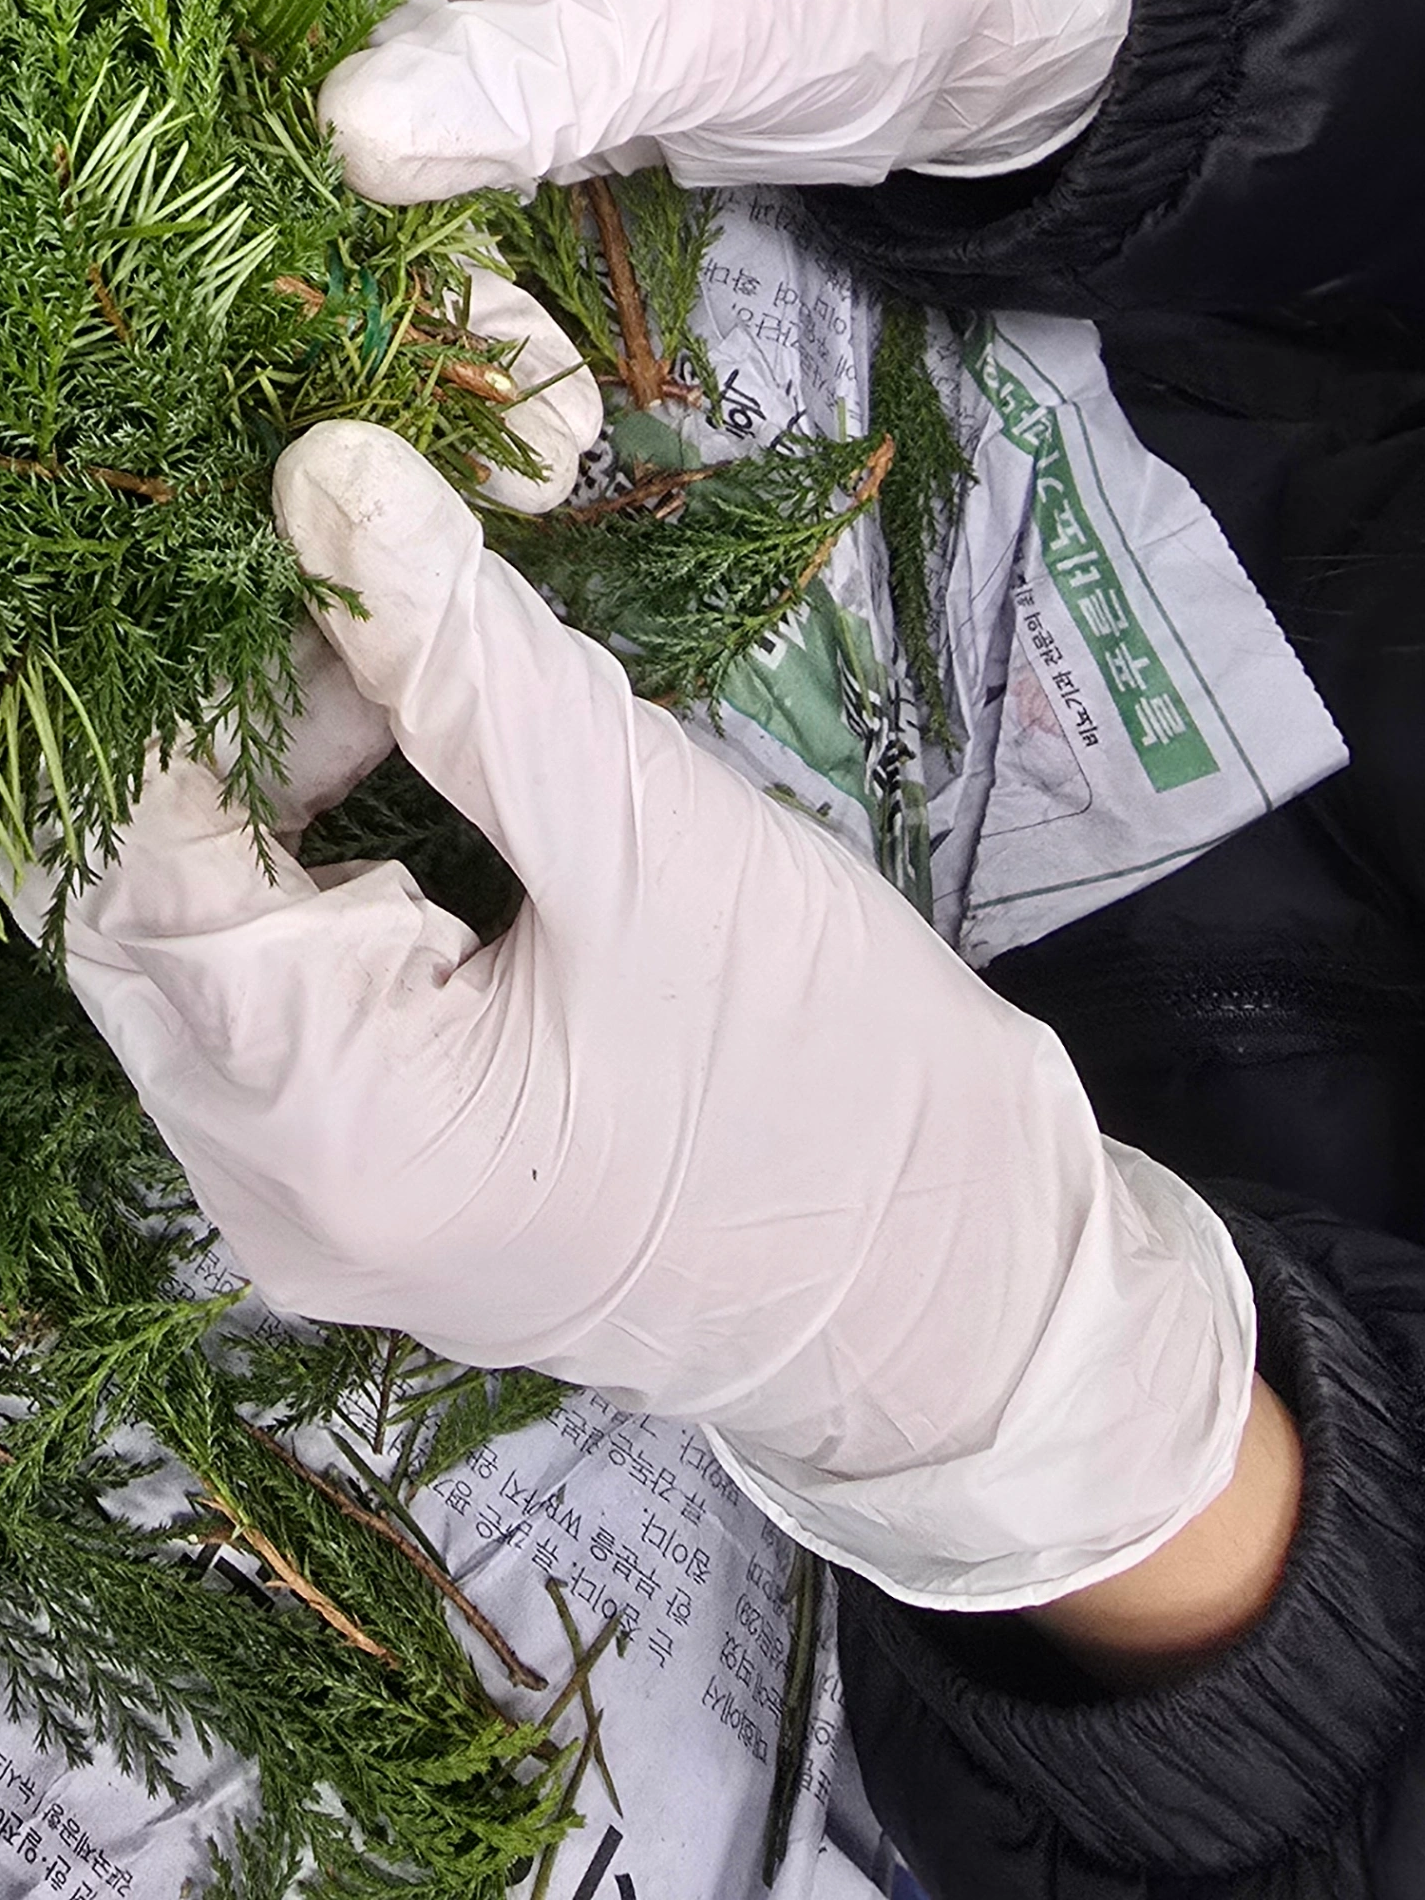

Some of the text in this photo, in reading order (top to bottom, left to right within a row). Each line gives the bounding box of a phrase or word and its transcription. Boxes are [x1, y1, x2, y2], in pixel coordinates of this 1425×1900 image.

[1024, 612, 1063, 666] 전문의
[1050, 669, 1101, 748] 비뇨기과
[604, 1432, 680, 1503] 감독은
[678, 1490, 709, 1528] 류
[530, 1536, 561, 1575] 류
[585, 1525, 665, 1601] 부분을
[663, 1586, 696, 1627] 한
